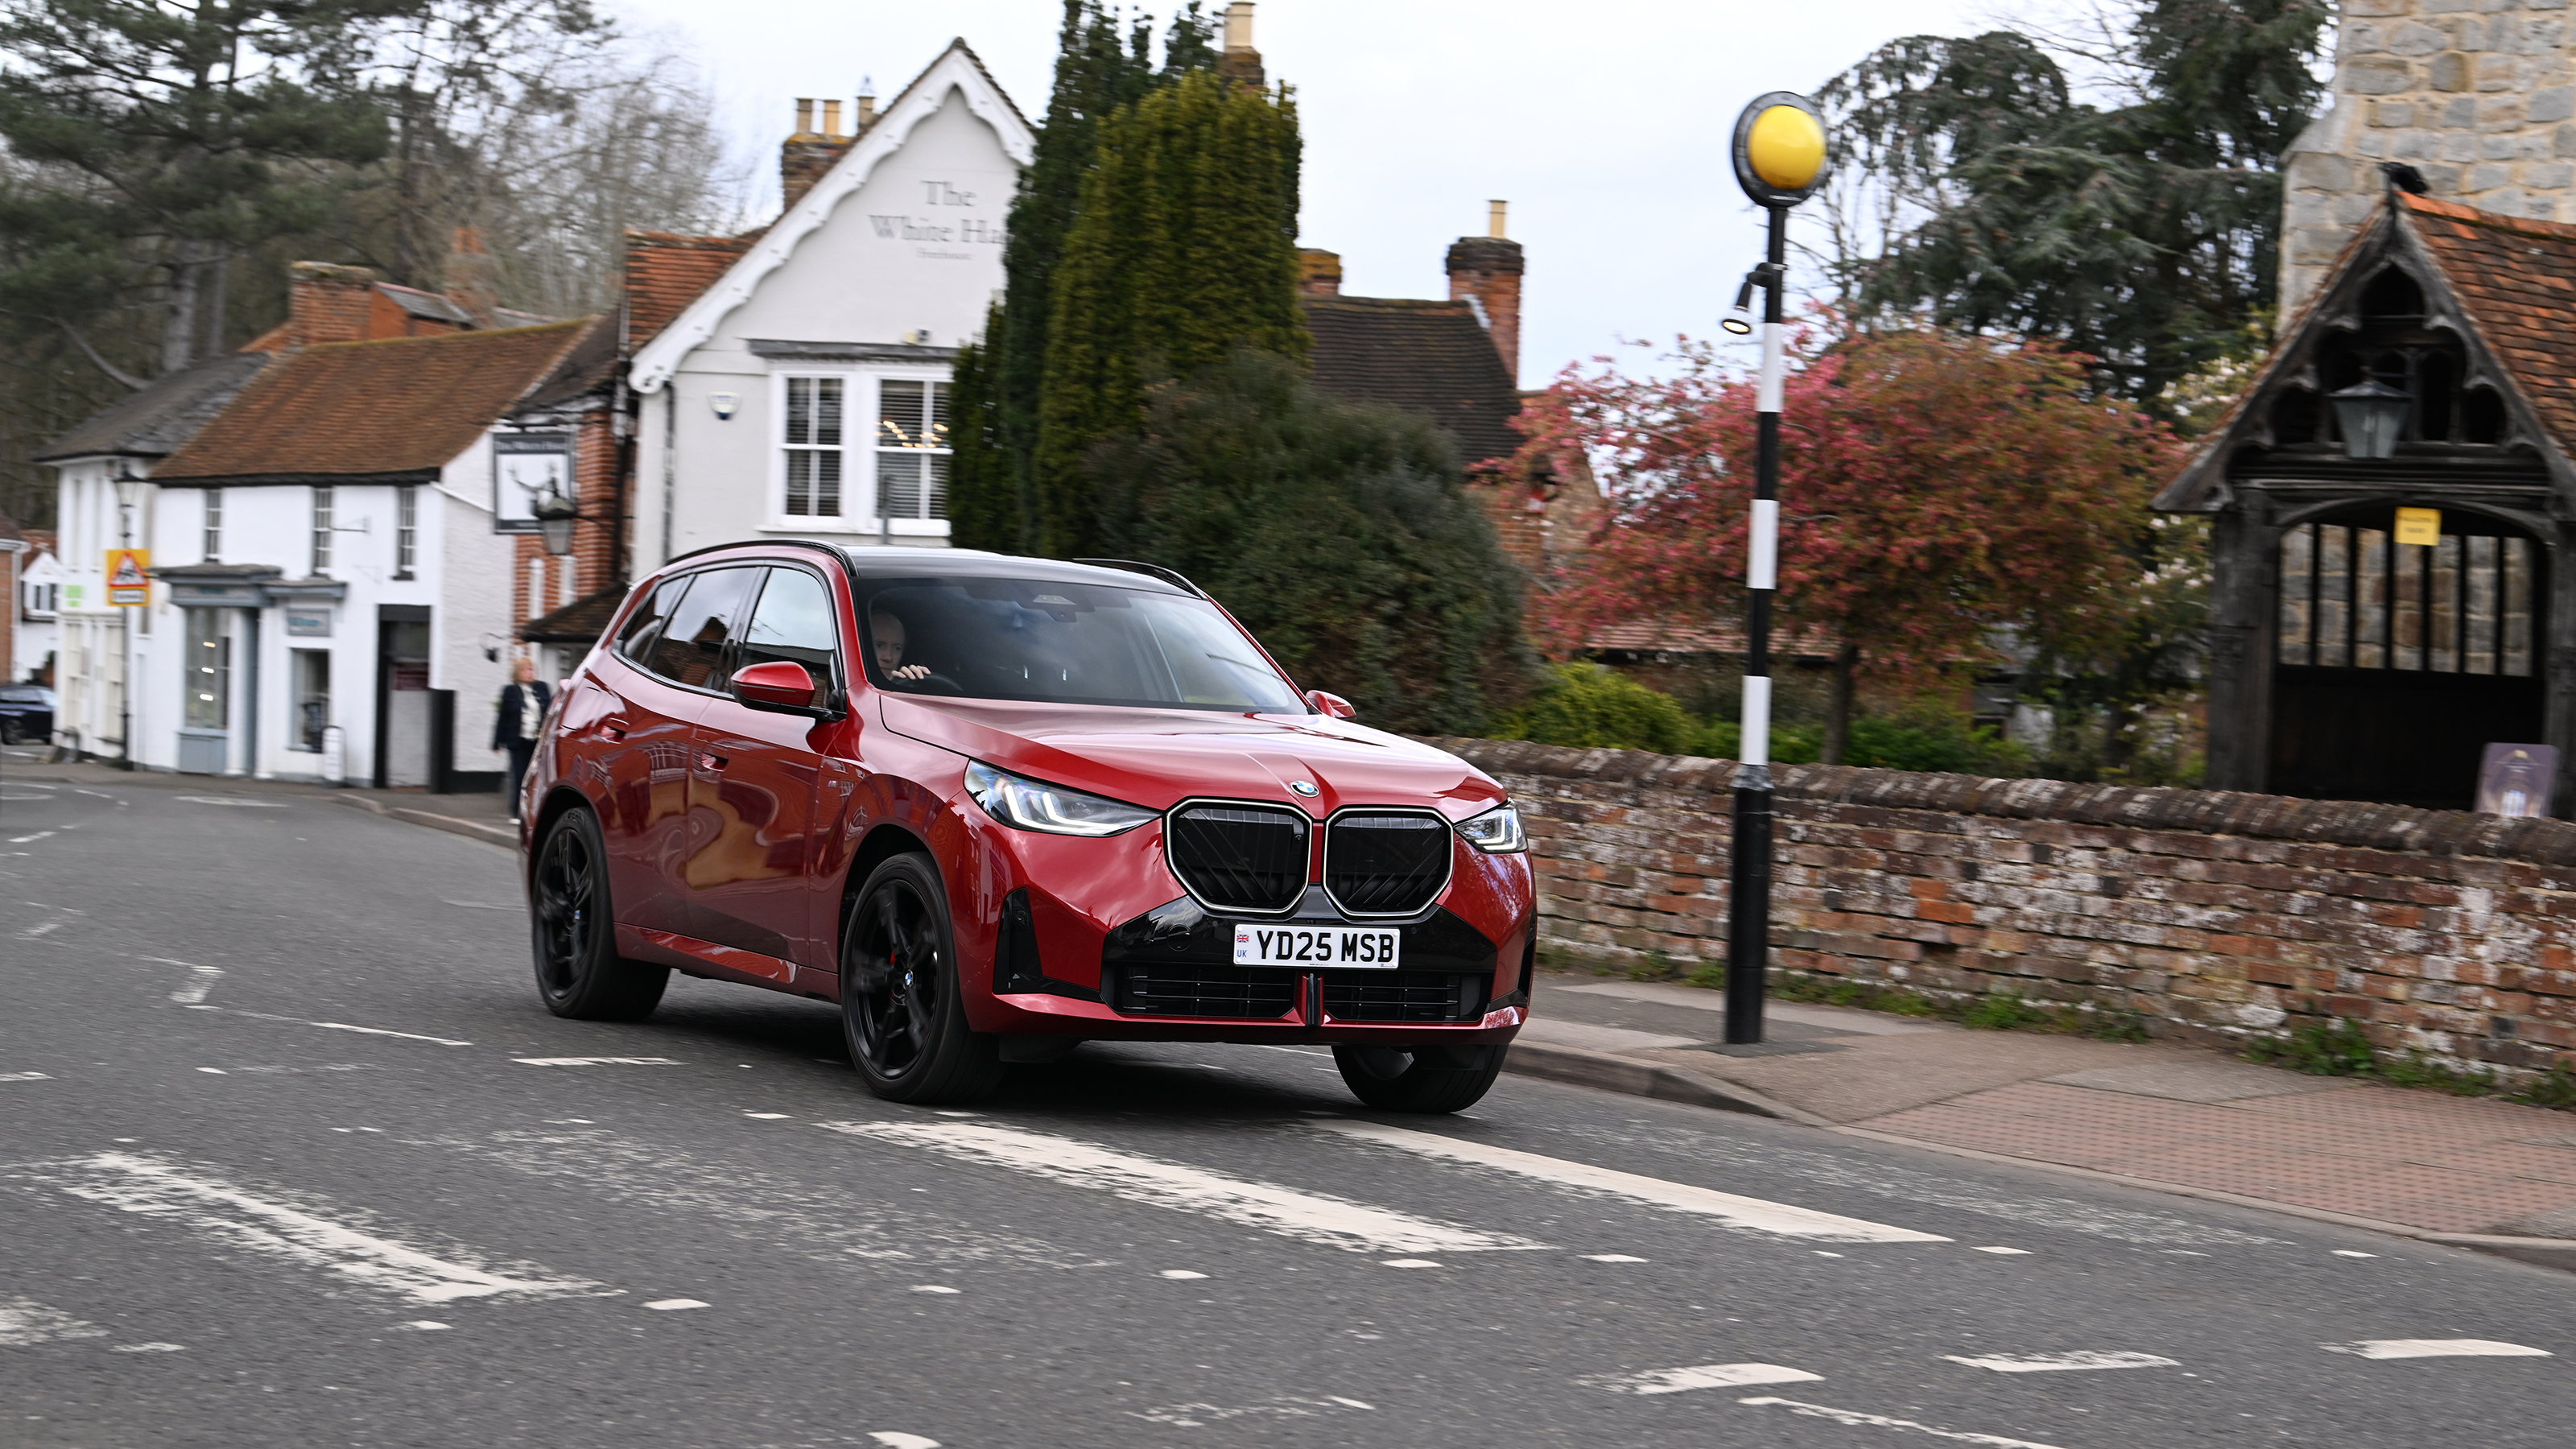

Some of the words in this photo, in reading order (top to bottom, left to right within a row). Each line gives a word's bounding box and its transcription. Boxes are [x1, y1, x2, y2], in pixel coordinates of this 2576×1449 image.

[920, 180, 976, 207] The
[869, 214, 953, 242] White
[960, 219, 1006, 245] Ha
[1236, 949, 1248, 958] UK
[1257, 930, 1332, 962] YD25
[1340, 932, 1394, 963] MSB
